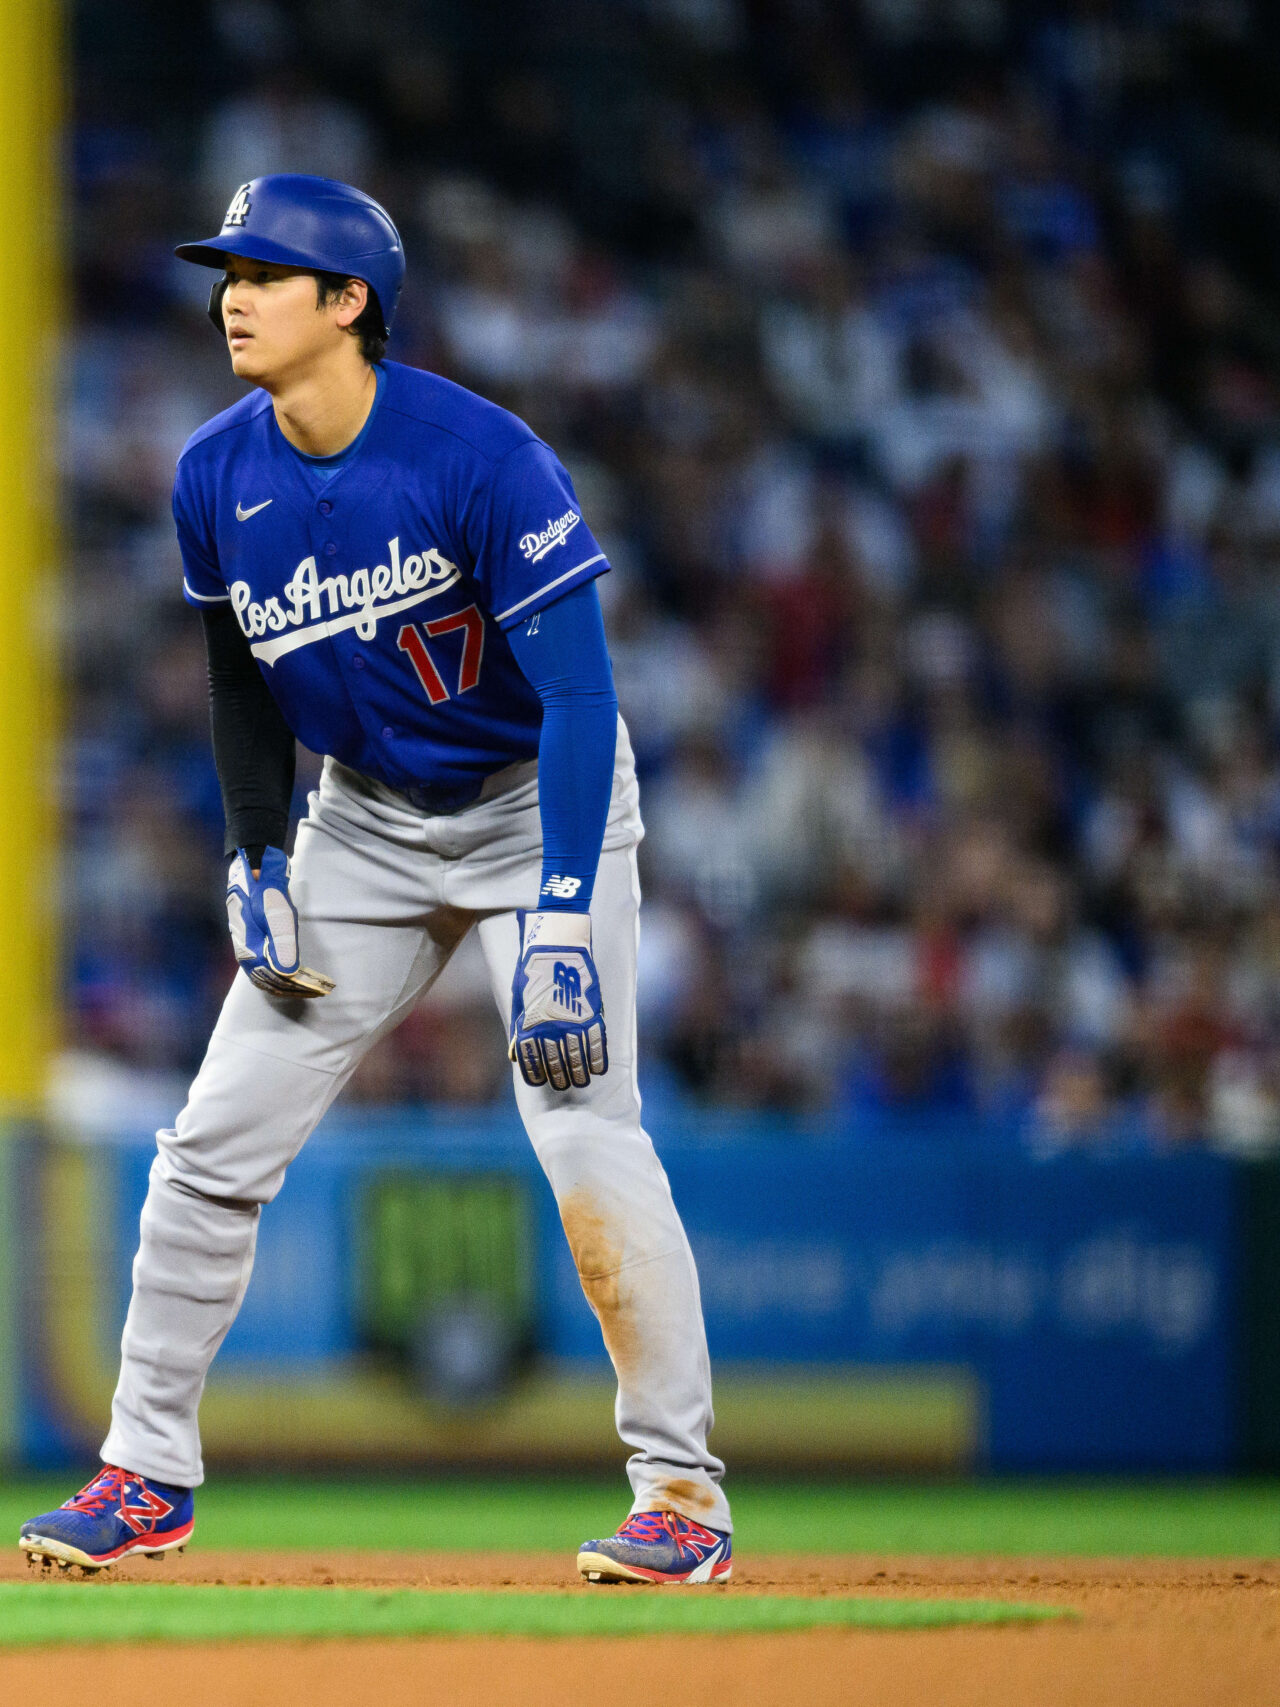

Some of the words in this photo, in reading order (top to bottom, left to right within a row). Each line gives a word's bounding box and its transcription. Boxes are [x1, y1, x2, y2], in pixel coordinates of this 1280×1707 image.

[224, 184, 250, 226] LA
[520, 510, 579, 560] Dodgers
[226, 580, 287, 639] Los
[284, 536, 458, 641] Angeles
[396, 602, 485, 704] 17
